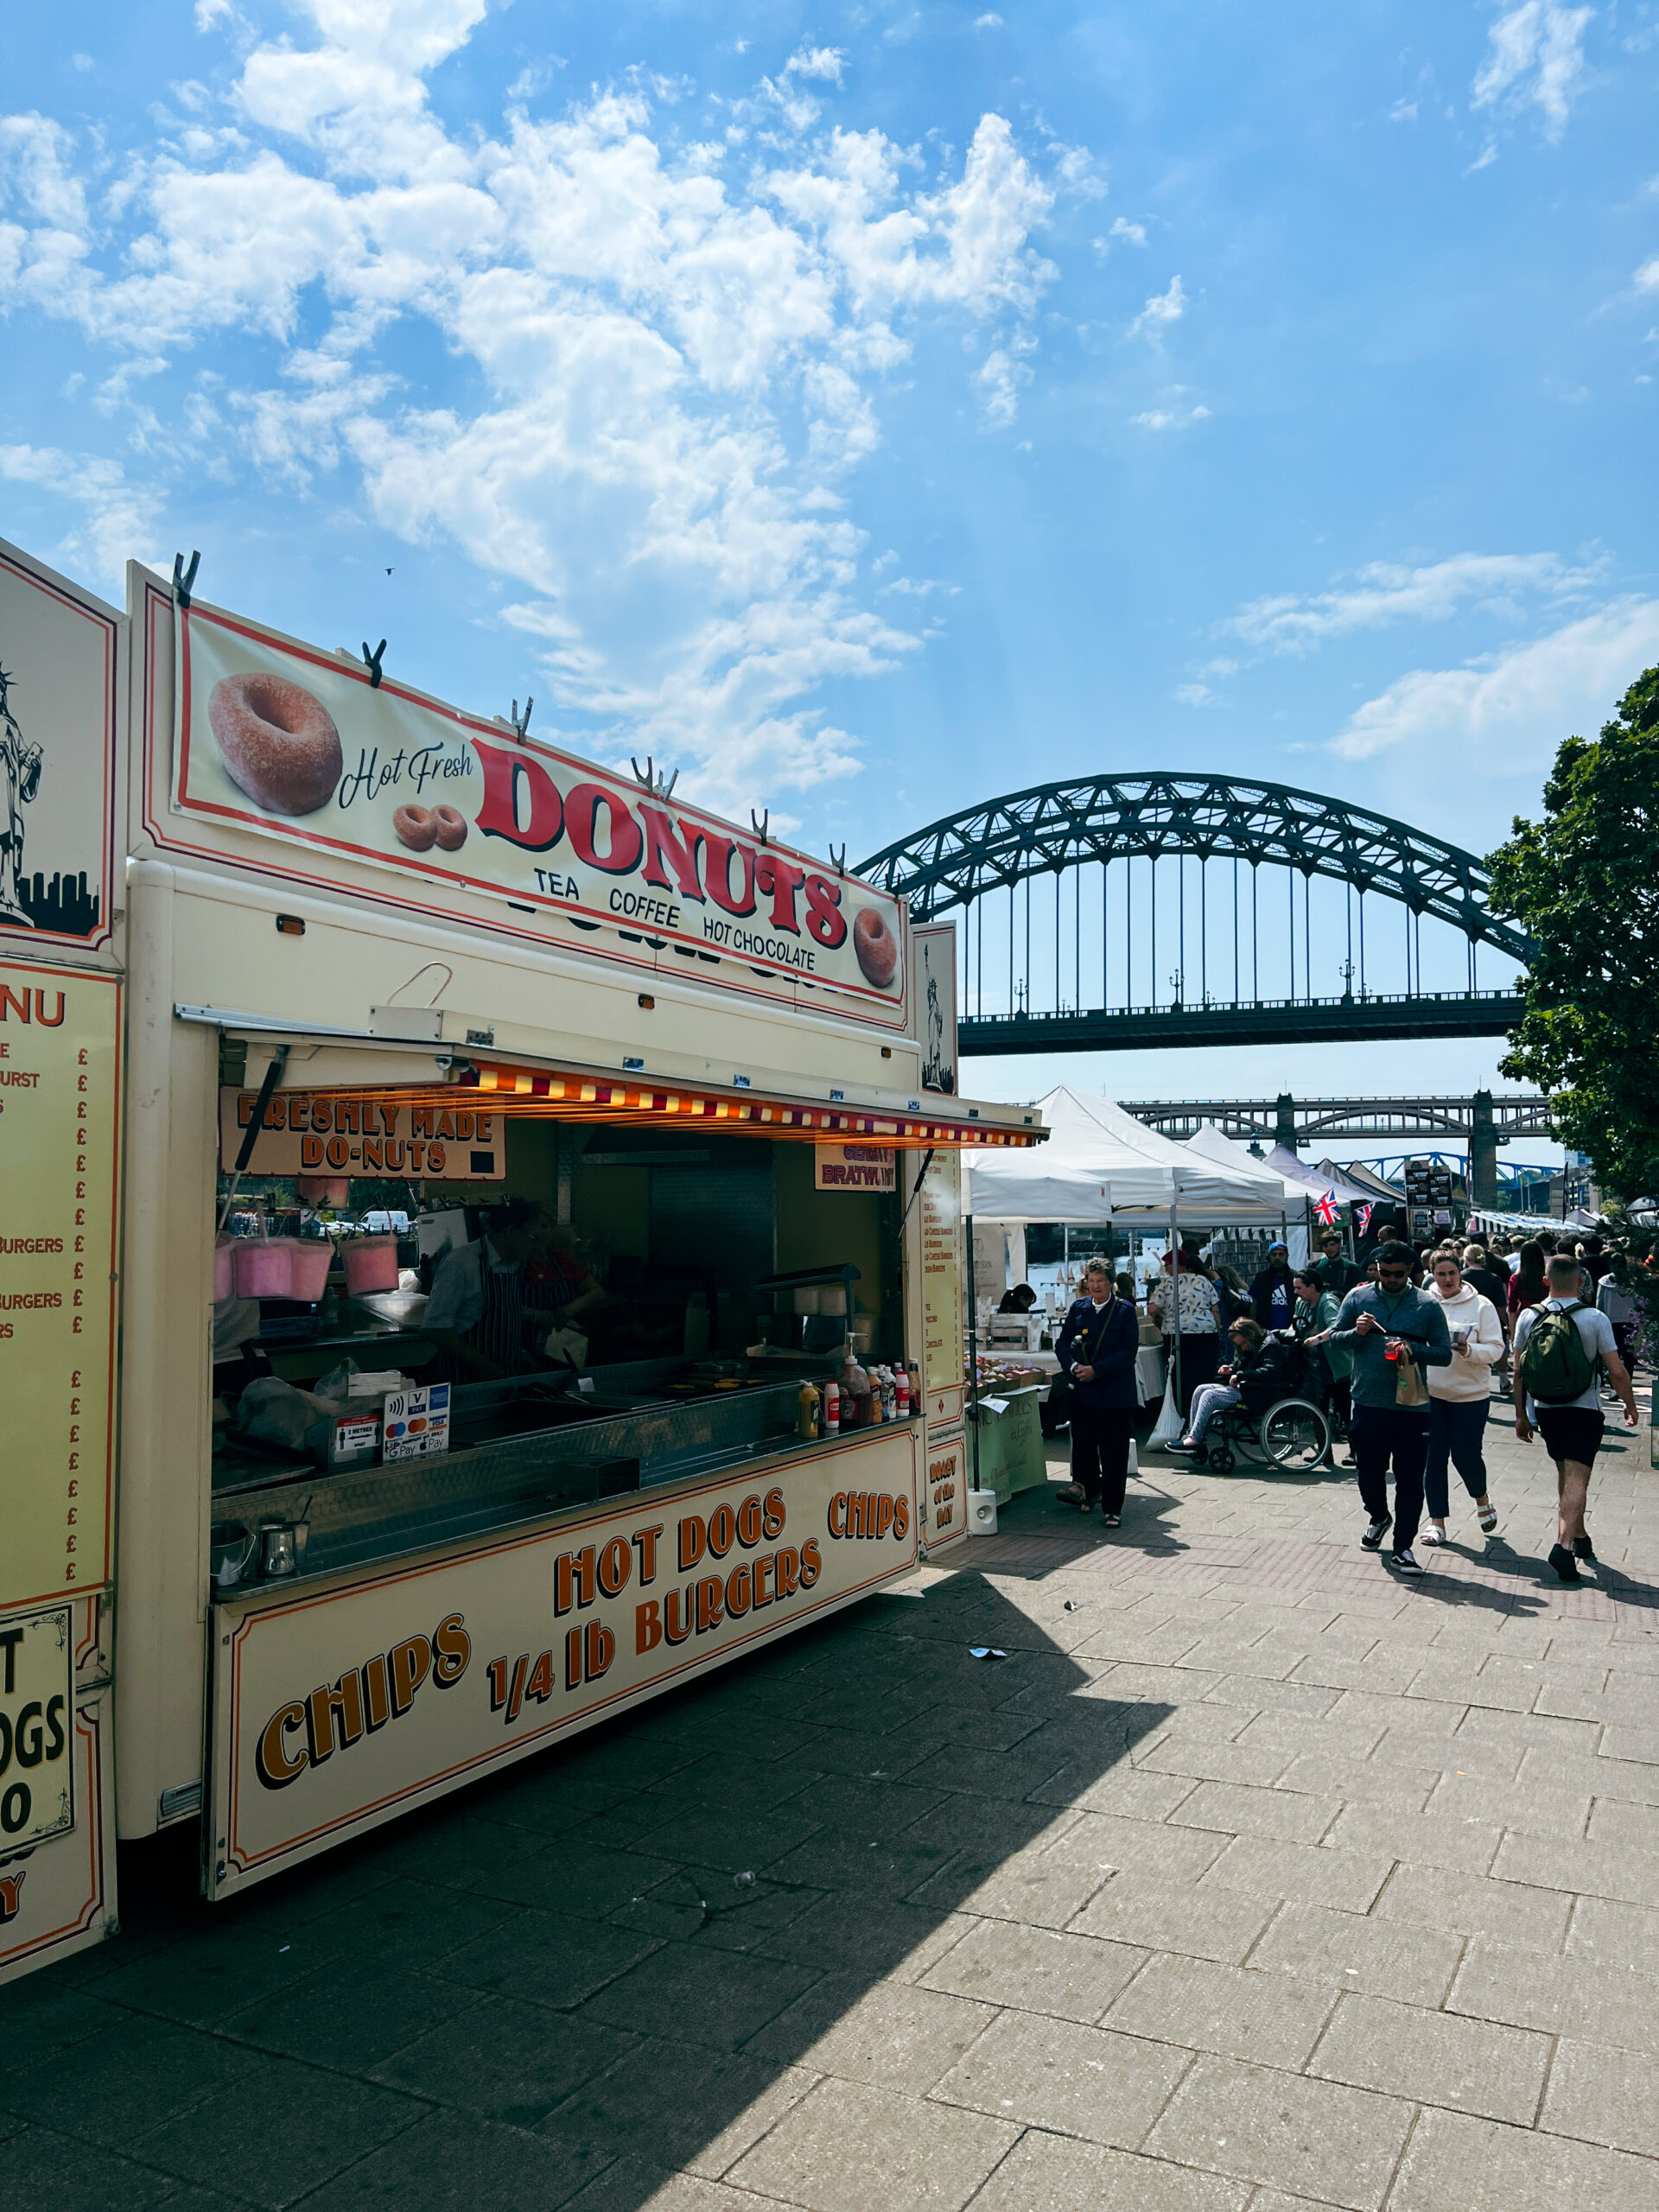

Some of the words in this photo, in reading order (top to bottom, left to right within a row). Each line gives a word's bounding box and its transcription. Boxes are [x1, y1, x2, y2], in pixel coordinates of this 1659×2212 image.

[339, 744, 406, 809] Hot
[408, 741, 474, 794] Fresh
[471, 737, 848, 950] DONUTS
[533, 868, 580, 902] TEA
[608, 887, 682, 930] COFFEE
[703, 916, 733, 944] HOT
[733, 923, 816, 972] CHOCOLATE
[0, 983, 66, 1027] NU
[237, 1093, 399, 1138] FRESHLY
[410, 1108, 493, 1142] MADE
[302, 1135, 447, 1173] DO-NUTS
[0, 1292, 62, 1311] URGERS
[400, 1446, 416, 1459] Pay
[429, 1438, 444, 1451] Pay
[828, 1491, 910, 1542] CHIPS
[937, 1503, 953, 1529] DAY
[943, 1482, 955, 1502] the
[554, 1523, 664, 1619] HOT
[678, 1487, 787, 1573] DOGS
[487, 1651, 555, 1725] 1/4
[565, 1618, 616, 1693] lb
[634, 1537, 822, 1656] BURGERS
[255, 1612, 472, 1790] CHIPS
